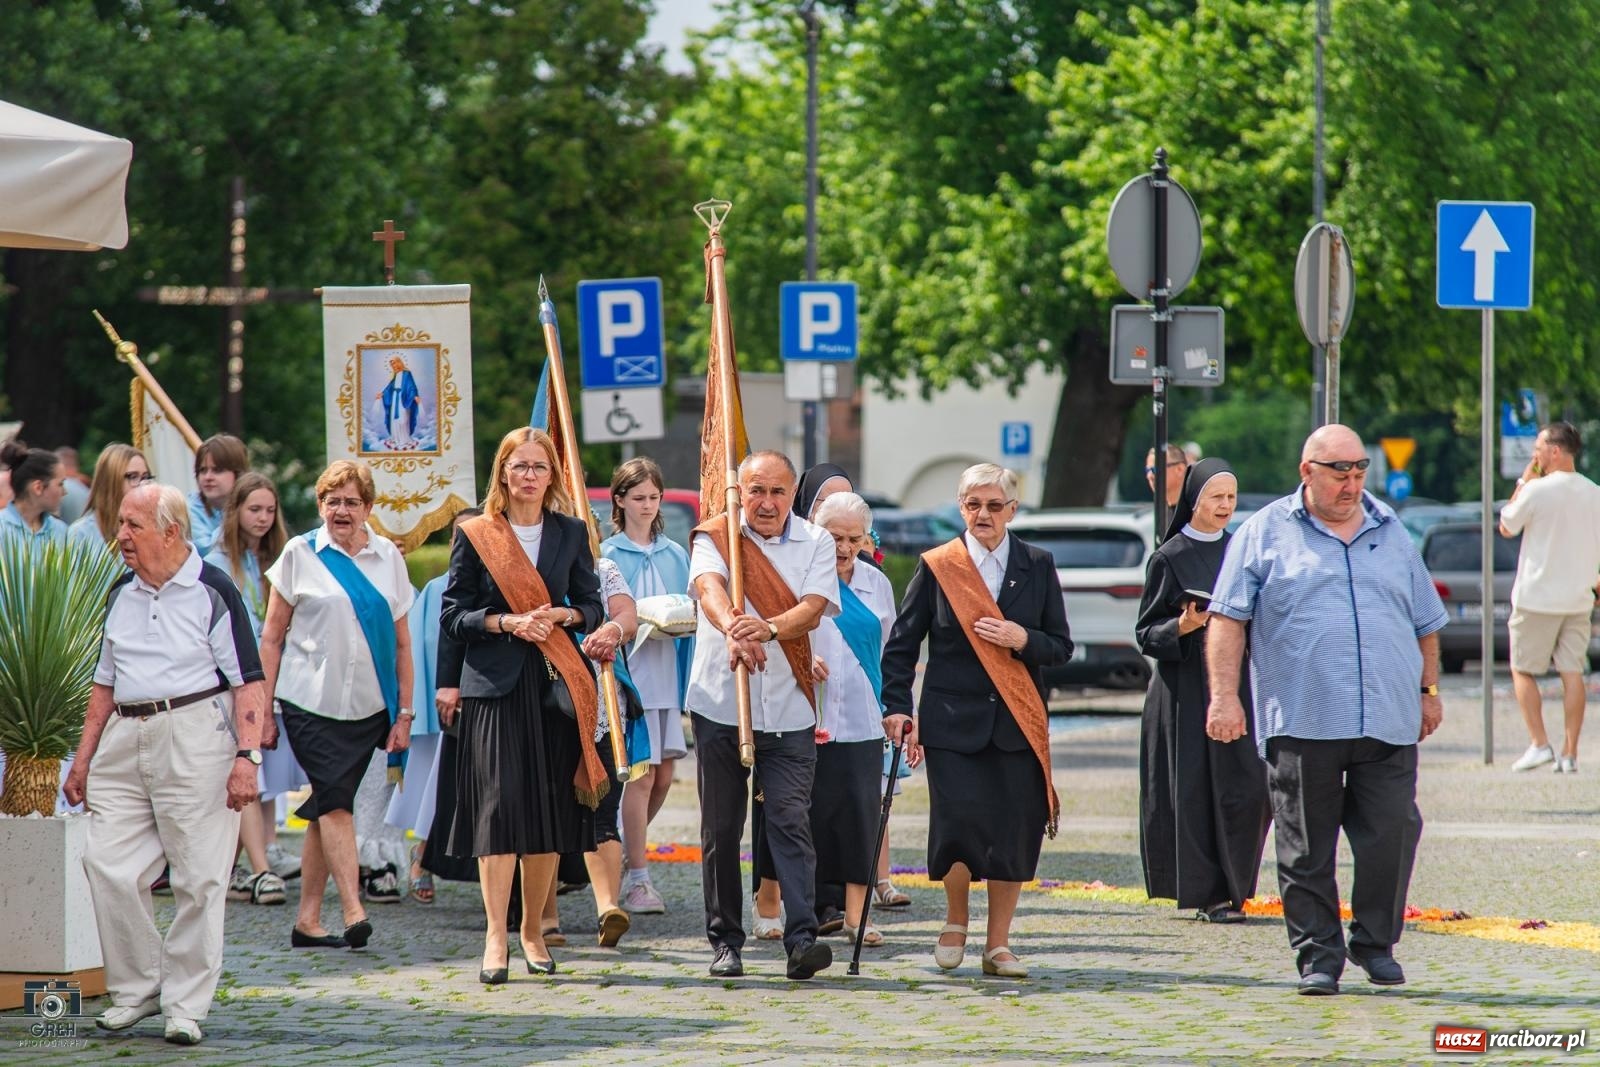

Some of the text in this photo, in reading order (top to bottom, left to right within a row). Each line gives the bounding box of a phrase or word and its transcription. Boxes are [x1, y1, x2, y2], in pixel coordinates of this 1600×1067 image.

[597, 289, 645, 357] P
[799, 291, 842, 351] P
[1007, 424, 1026, 449] P
